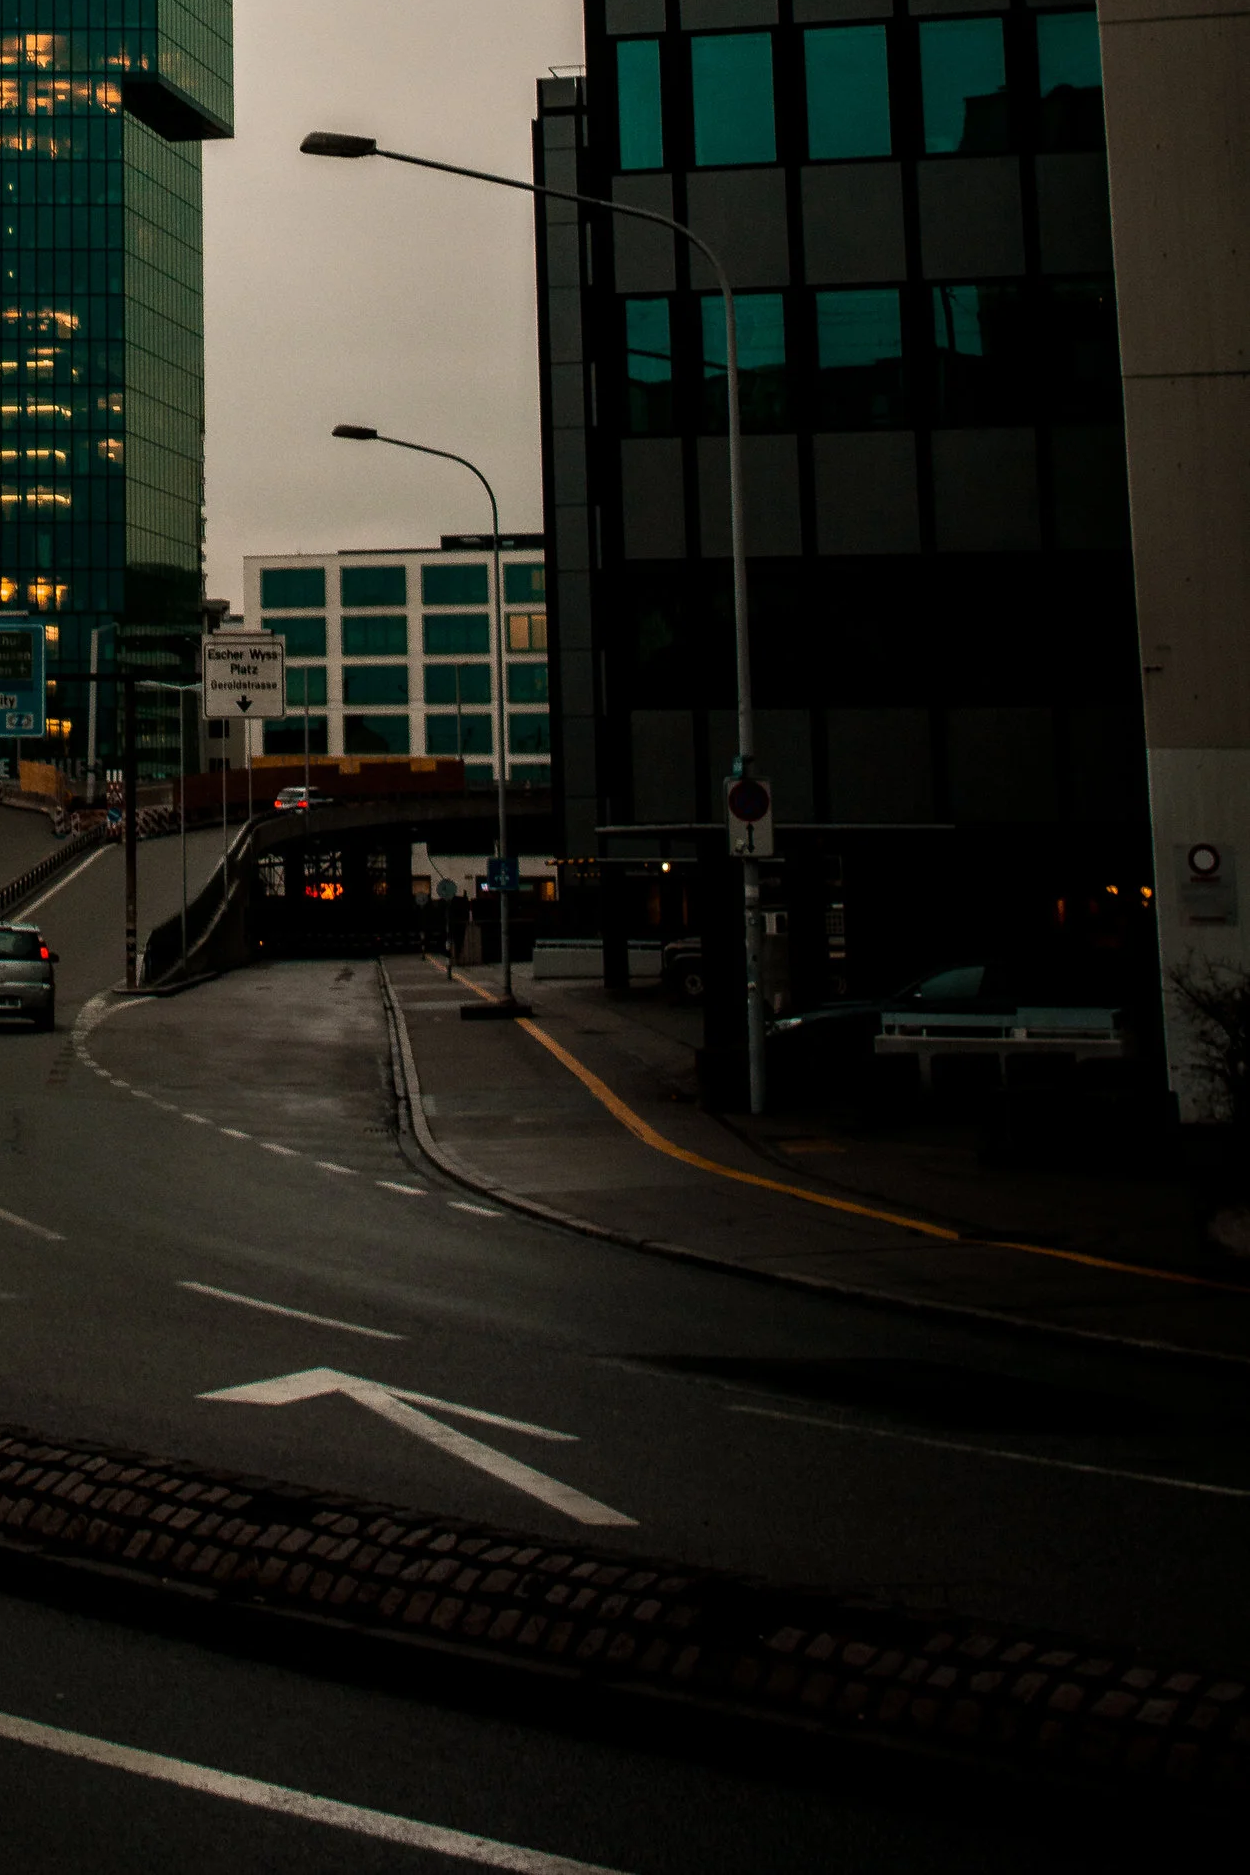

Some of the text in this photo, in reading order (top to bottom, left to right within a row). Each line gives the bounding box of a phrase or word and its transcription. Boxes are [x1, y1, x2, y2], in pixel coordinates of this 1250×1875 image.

[208, 649, 244, 660] Escher
[230, 663, 259, 675] Platz
[211, 679, 278, 690] Geroldstrasse
